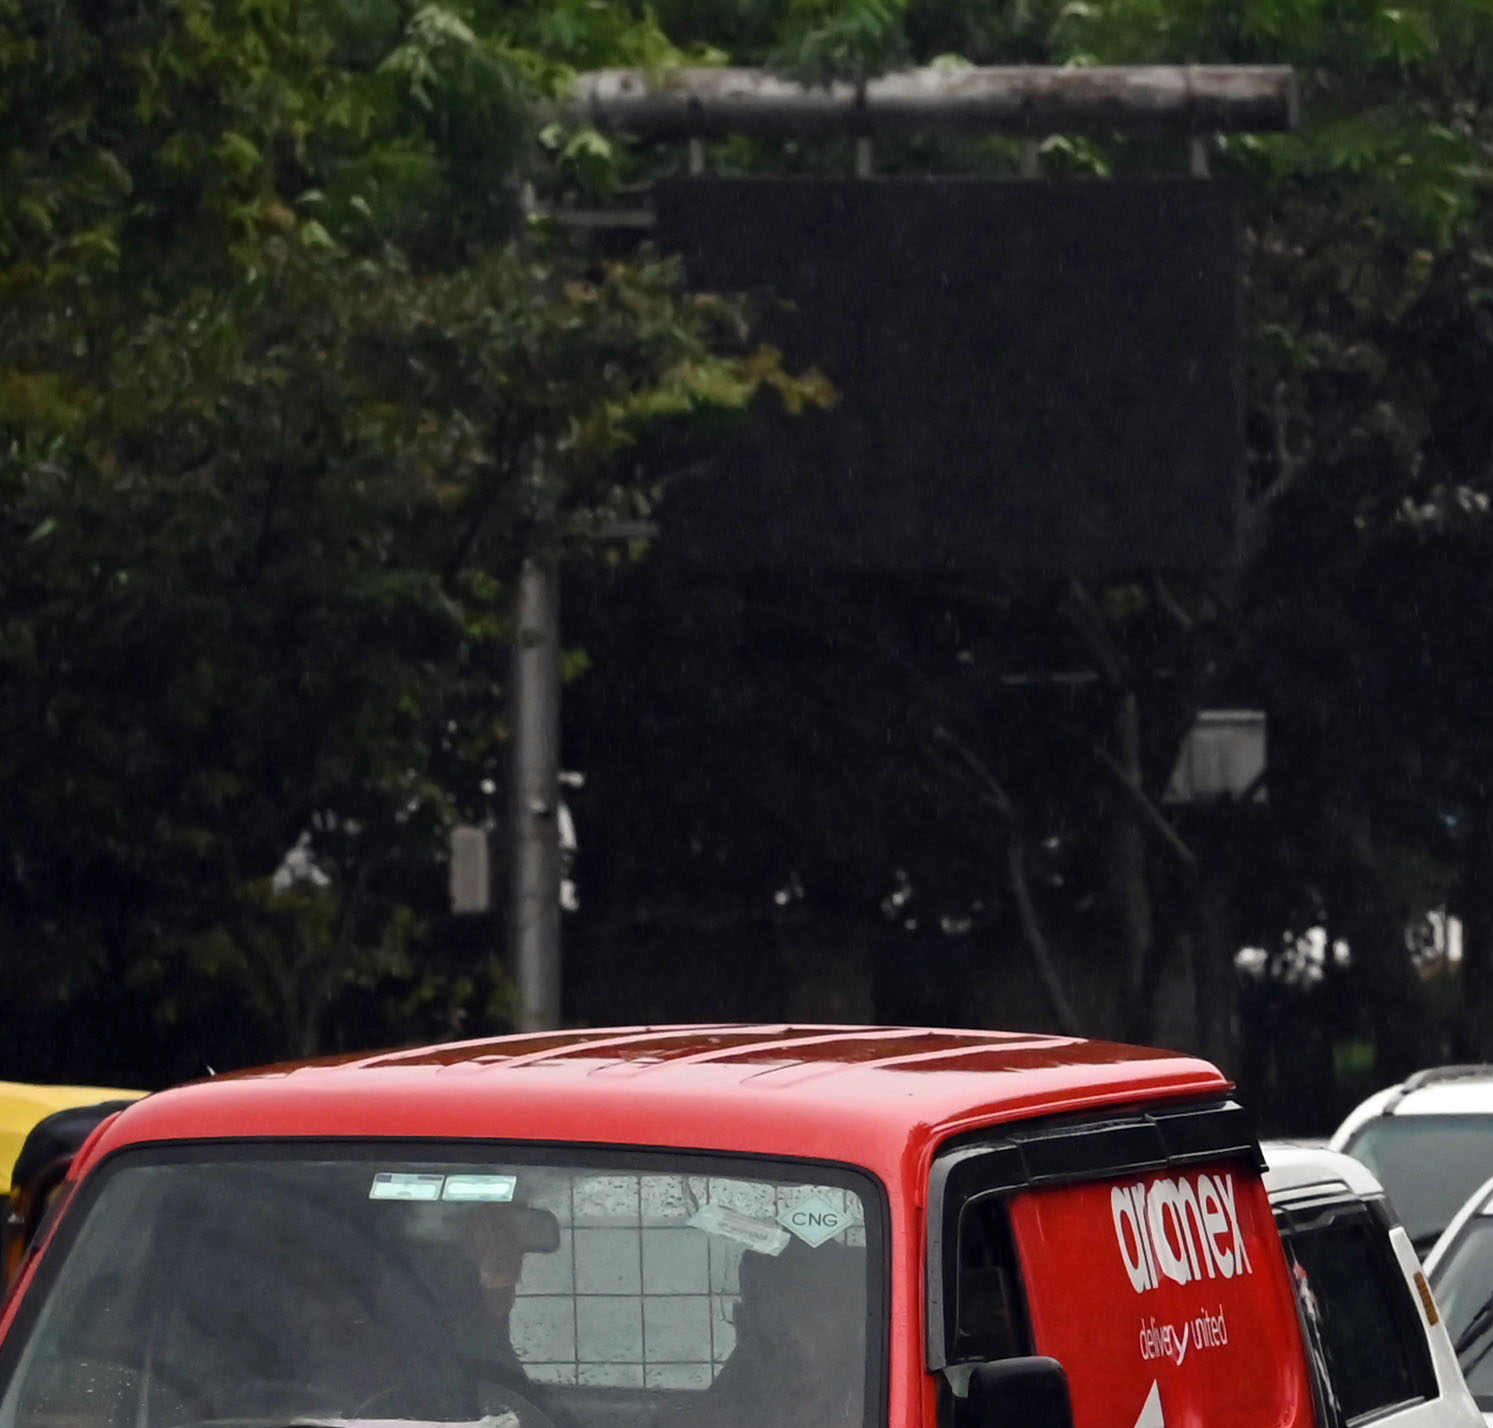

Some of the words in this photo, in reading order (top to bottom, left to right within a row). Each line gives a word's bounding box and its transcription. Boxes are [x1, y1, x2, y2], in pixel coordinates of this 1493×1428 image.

[792, 1212, 838, 1227] CNG
[1110, 1173, 1252, 1294] aramex
[1139, 1317, 1189, 1366] delivery
[1192, 1304, 1228, 1350] united
